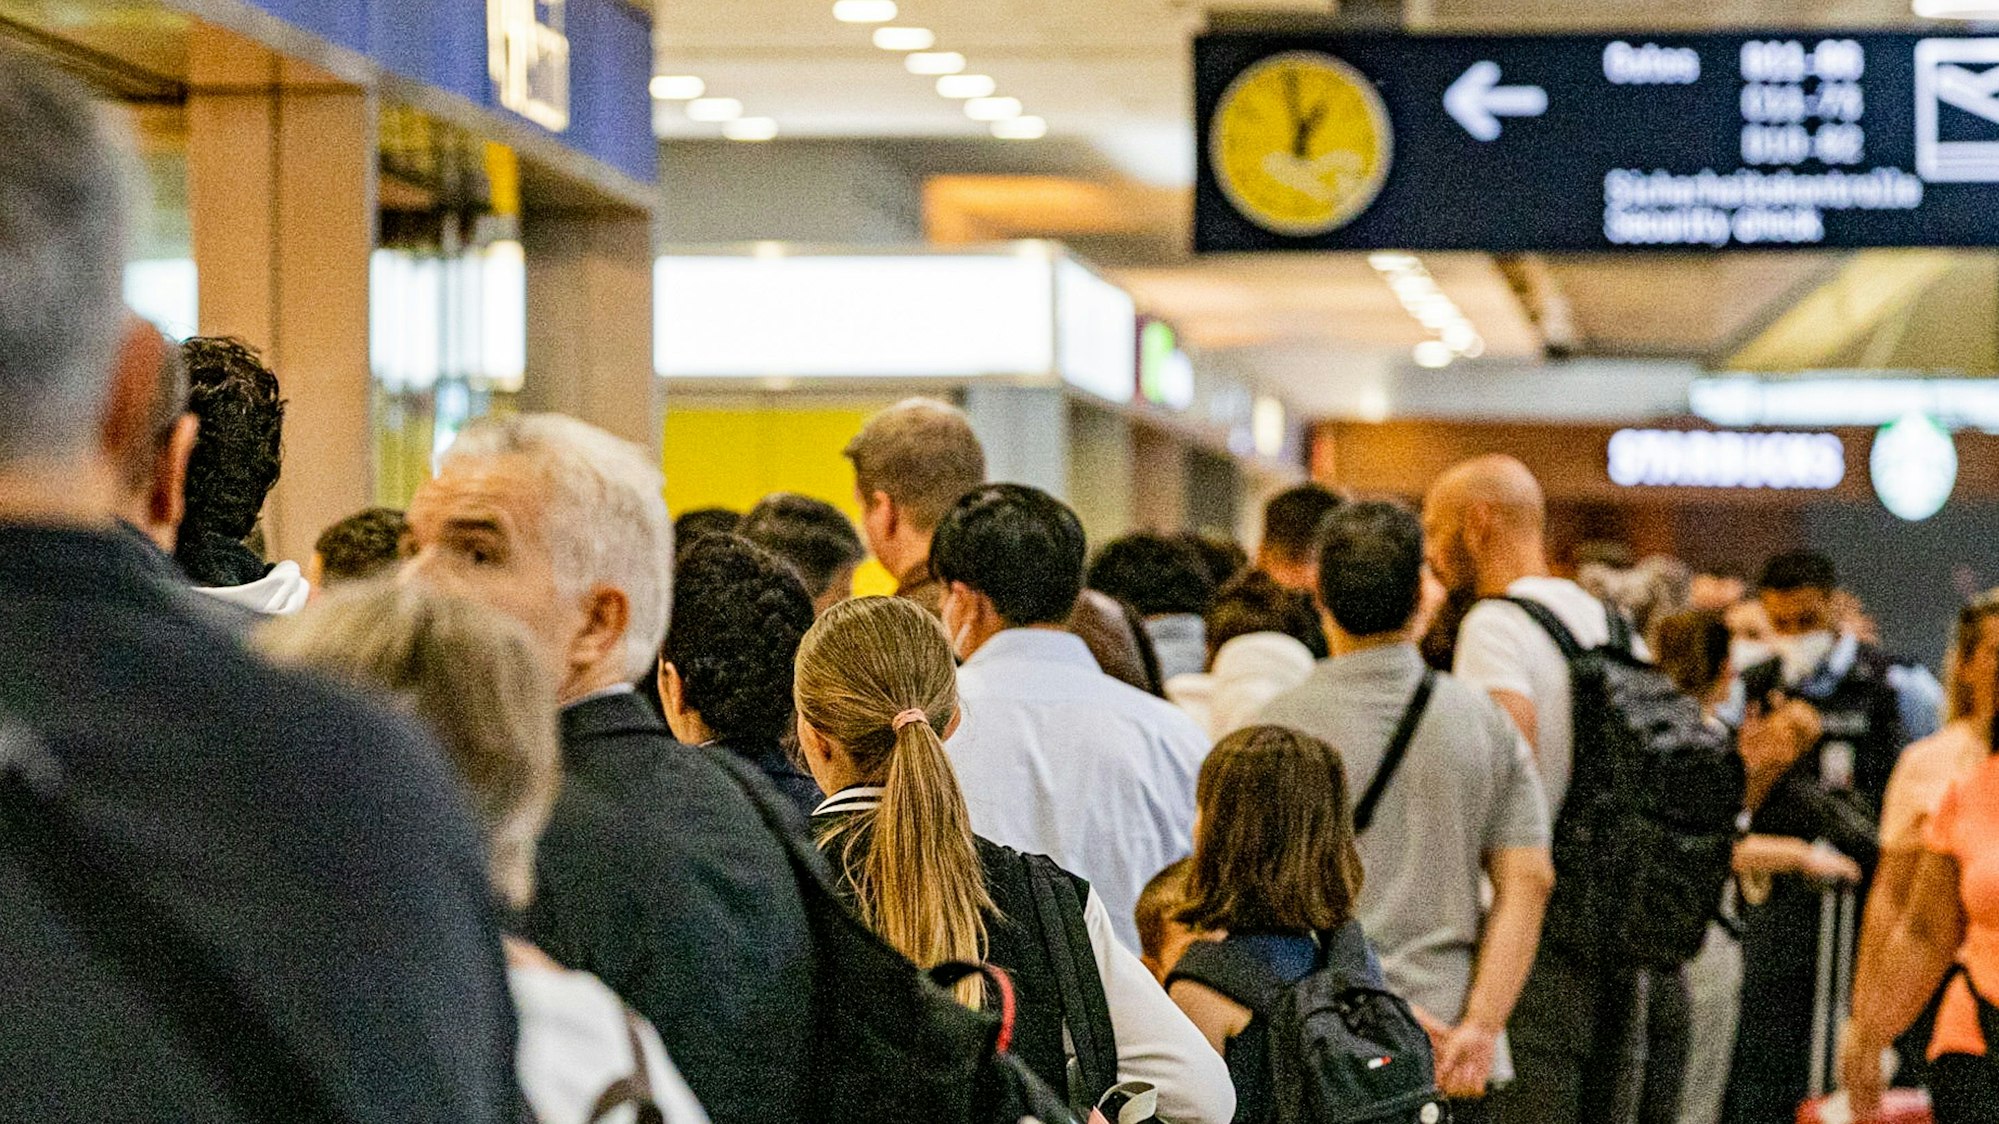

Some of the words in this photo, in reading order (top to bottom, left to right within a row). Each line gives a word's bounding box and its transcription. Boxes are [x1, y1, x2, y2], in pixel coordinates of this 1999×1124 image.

[1604, 42, 1699, 84] Gates
[1603, 204, 1730, 246] Security
[1733, 205, 1824, 243] check
[1609, 430, 1844, 488] STARBUCKS
